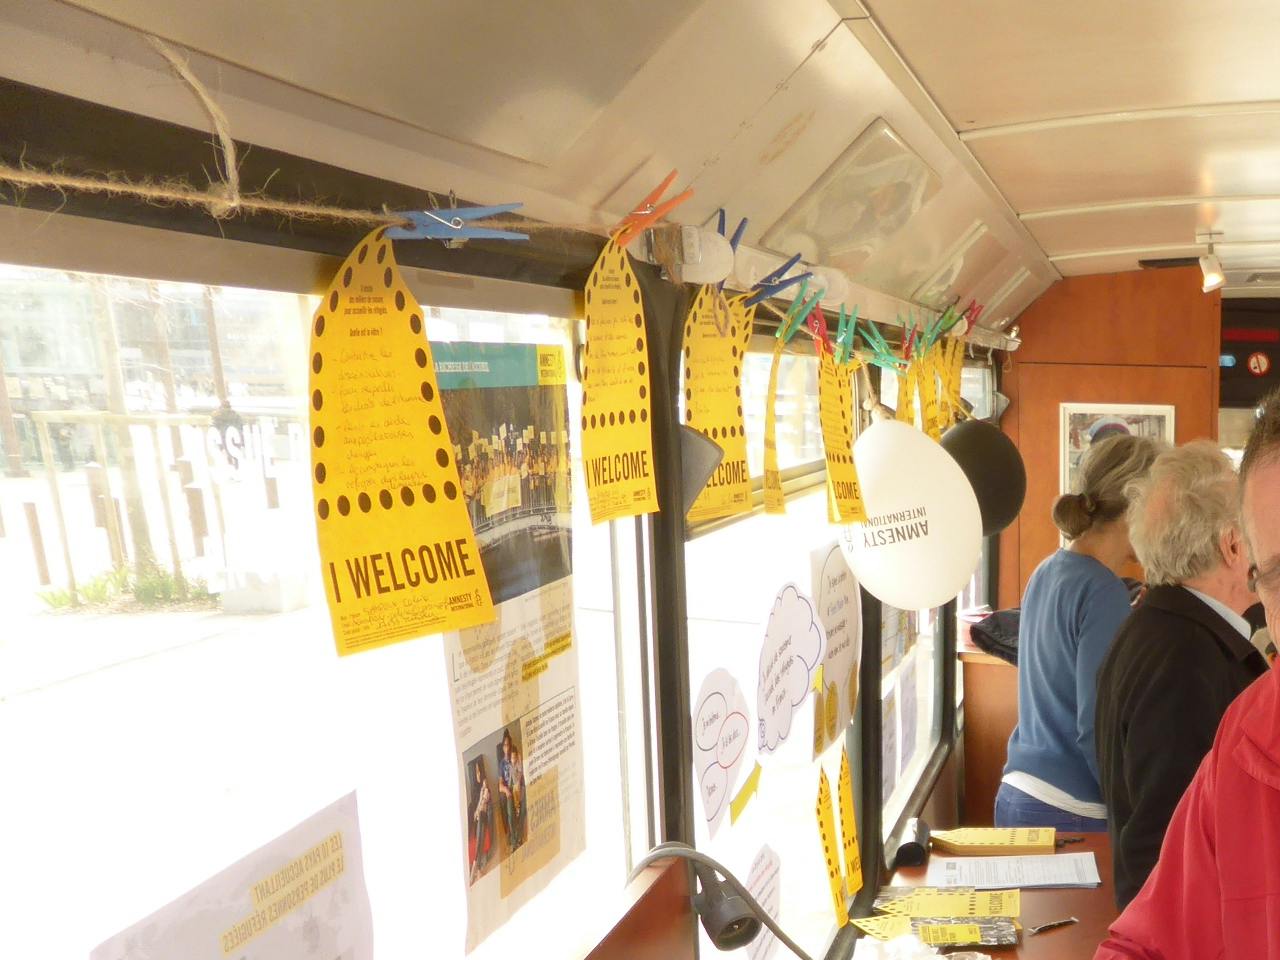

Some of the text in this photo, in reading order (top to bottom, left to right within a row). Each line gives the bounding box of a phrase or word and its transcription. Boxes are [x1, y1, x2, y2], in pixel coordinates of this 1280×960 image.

[591, 450, 649, 490] WELCOME
[863, 520, 929, 548] AMNESTY
[329, 537, 476, 604] I WELCOME
